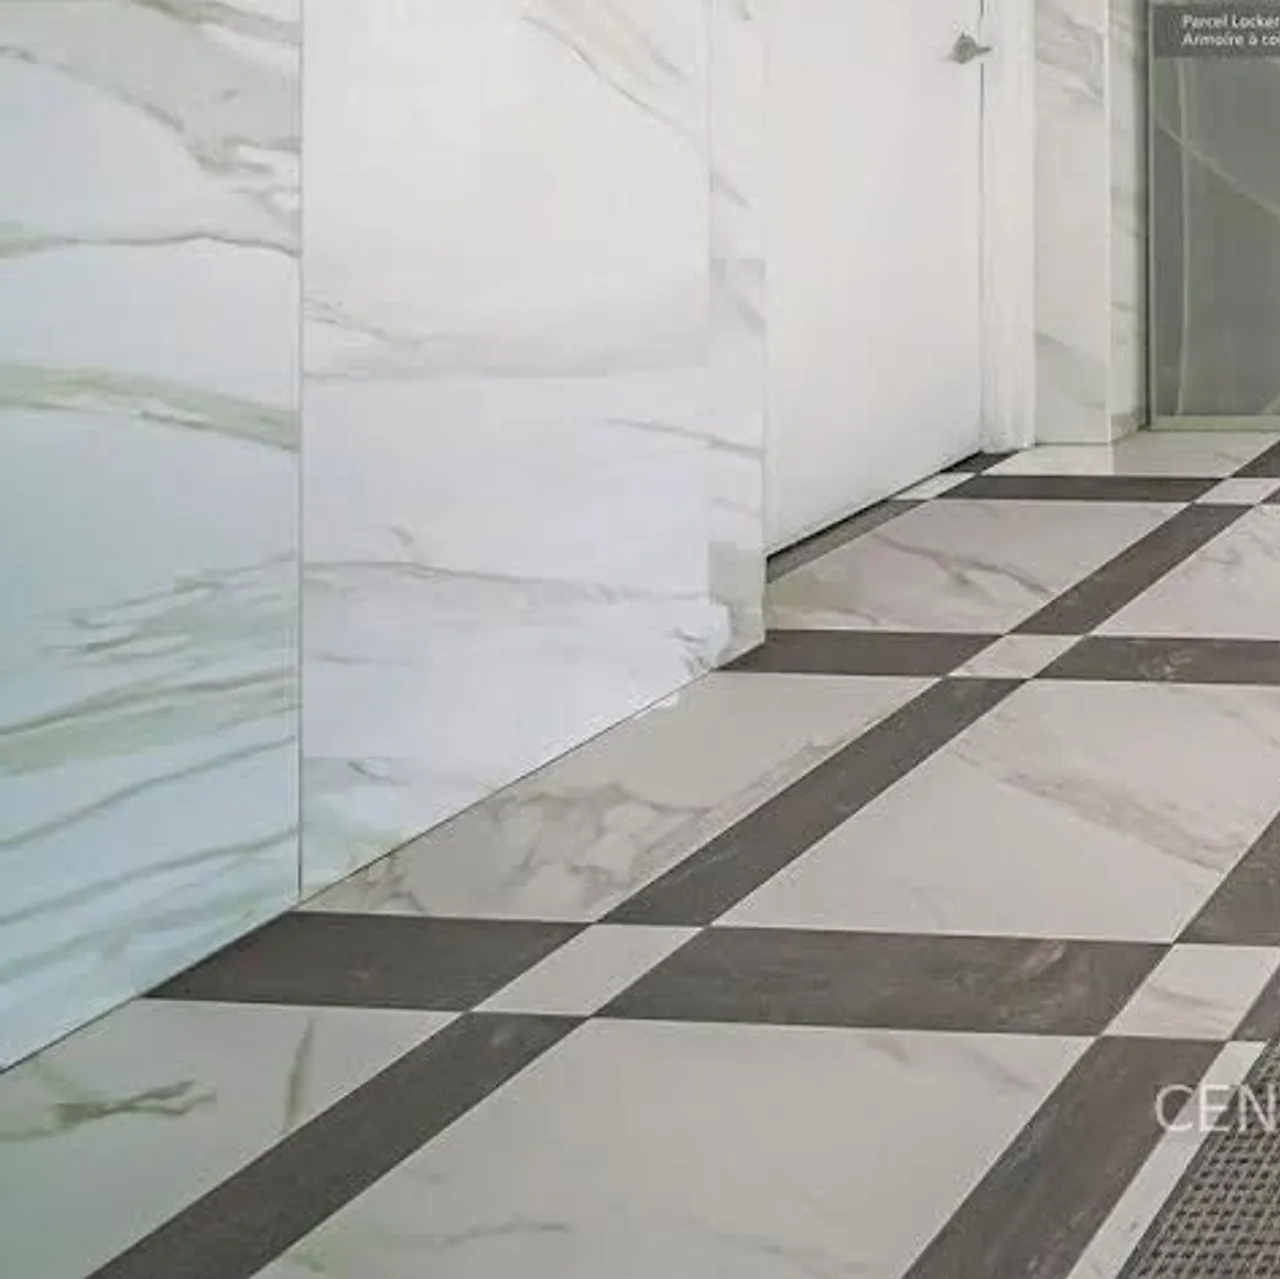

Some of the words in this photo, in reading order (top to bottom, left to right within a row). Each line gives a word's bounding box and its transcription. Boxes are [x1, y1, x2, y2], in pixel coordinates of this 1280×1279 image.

[1182, 13, 1229, 30] Parcel
[1231, 13, 1280, 30] Locker
[1181, 32, 1245, 47] Armoire
